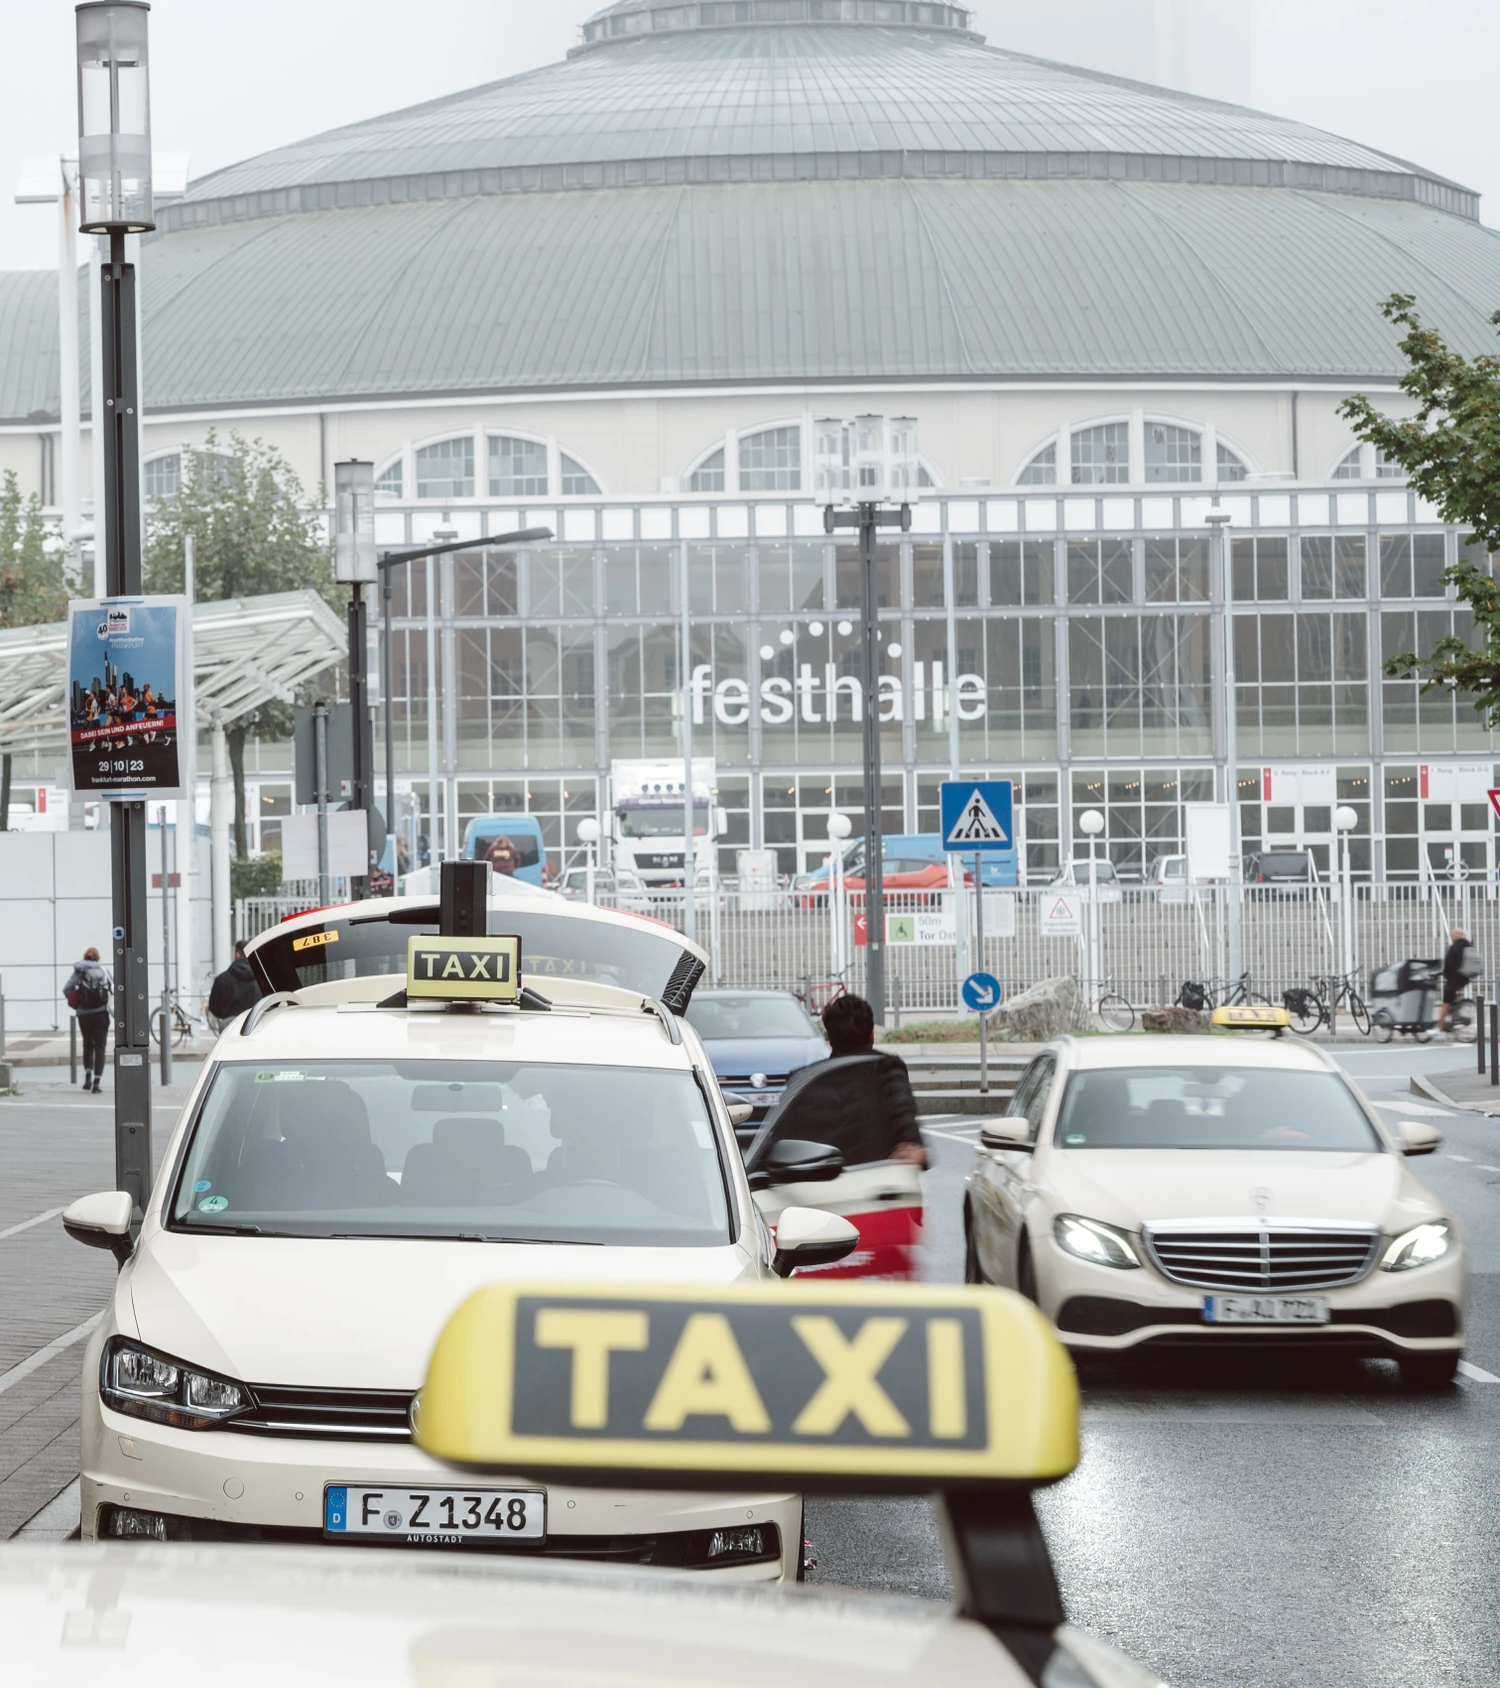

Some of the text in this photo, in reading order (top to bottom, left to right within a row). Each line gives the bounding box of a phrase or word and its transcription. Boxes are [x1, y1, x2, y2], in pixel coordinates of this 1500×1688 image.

[97, 624, 108, 636] 40
[689, 661, 987, 724] festhalle
[80, 720, 164, 739] DABEI SEIN UND ANFEUERN!
[91, 775, 157, 783] frankfurt-marathon.com
[918, 916, 941, 926] 50m
[302, 933, 332, 947] 387
[918, 931, 935, 940] Tor
[421, 953, 504, 979] TAXI
[535, 1309, 968, 1439] TAXI
[362, 1493, 384, 1526] F
[332, 1513, 341, 1524] D
[406, 1534, 463, 1544] AUTOSTADT
